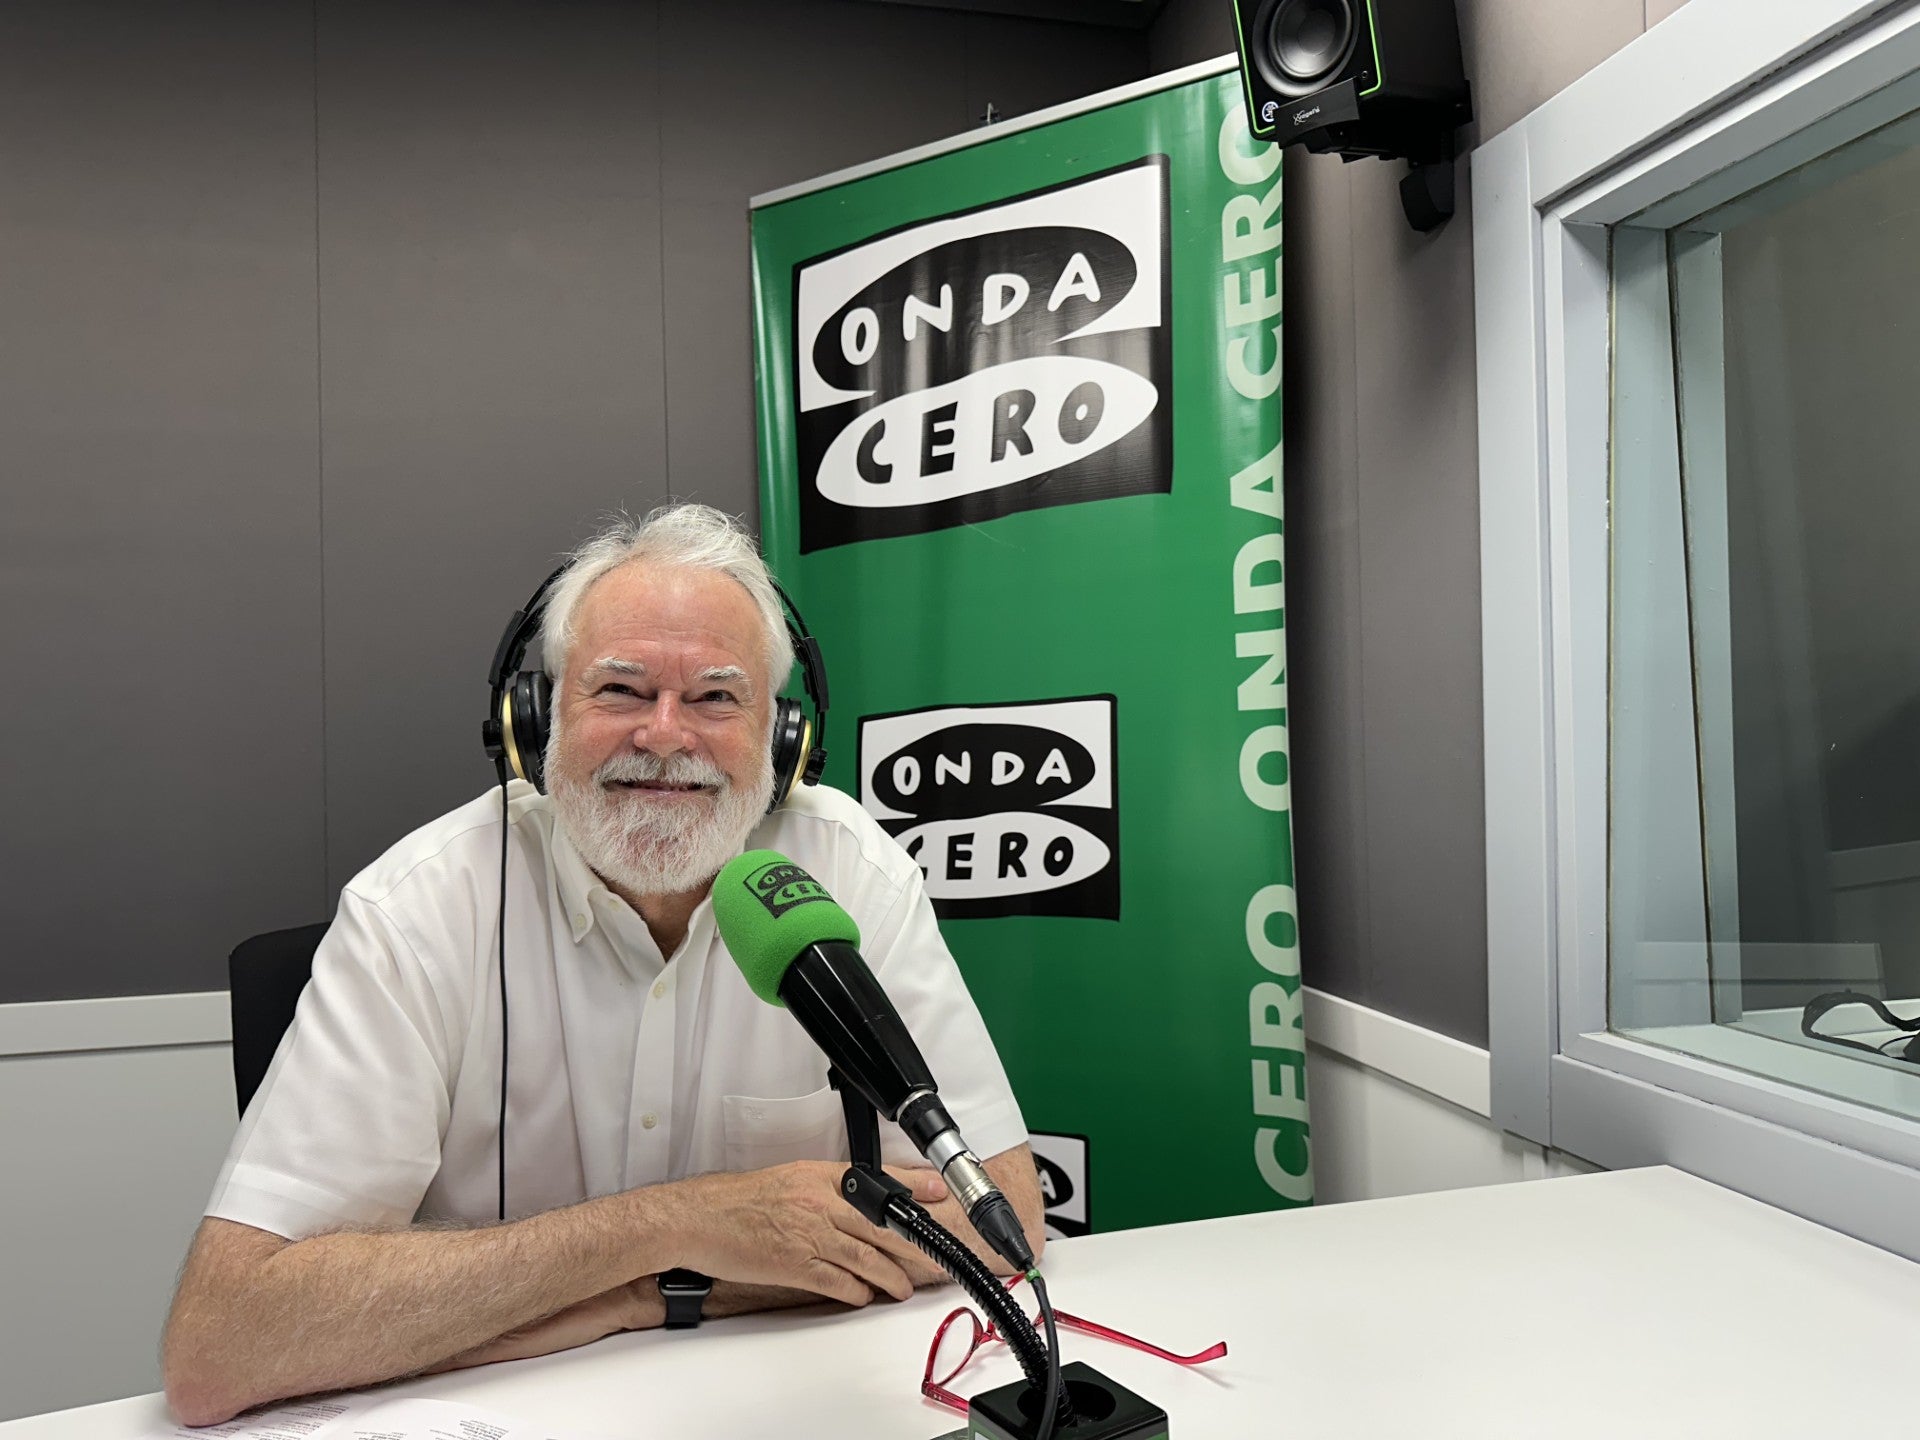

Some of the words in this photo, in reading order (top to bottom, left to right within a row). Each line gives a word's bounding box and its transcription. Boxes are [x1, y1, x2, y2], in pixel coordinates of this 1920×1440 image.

[840, 252, 1101, 365] ONDA
[856, 381, 1105, 484] CERO
[1230, 440, 1290, 812] ONDA
[892, 748, 1072, 795] ONDA
[763, 869, 808, 884] OND
[781, 883, 826, 898] CER
[1246, 883, 1314, 1202] CERO
